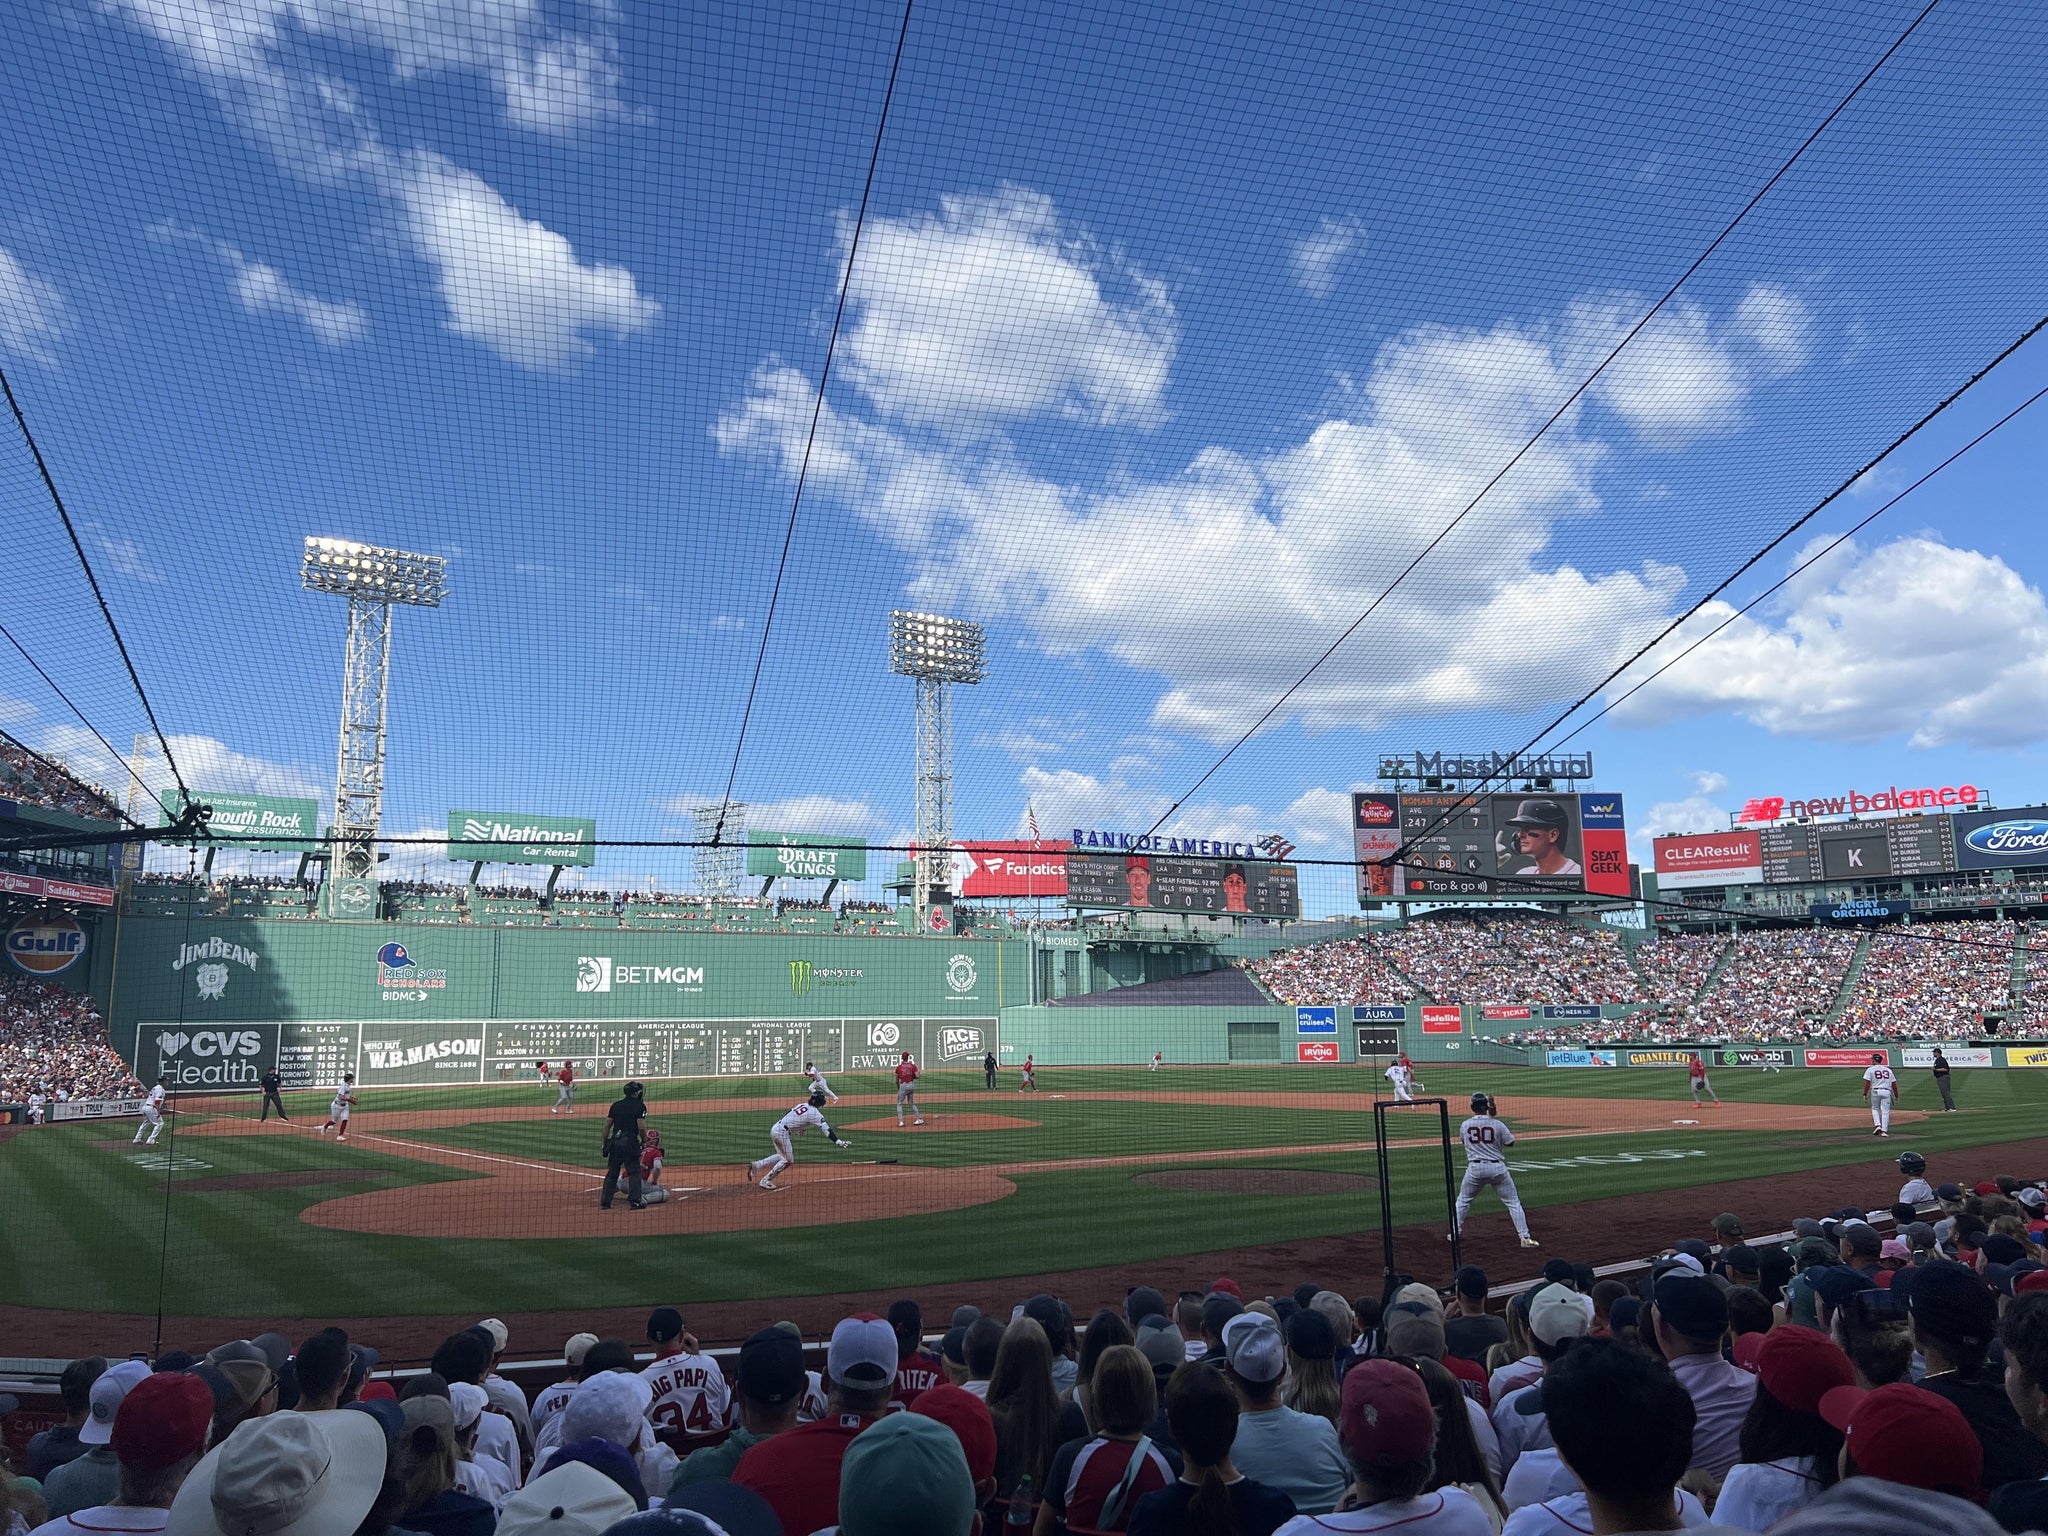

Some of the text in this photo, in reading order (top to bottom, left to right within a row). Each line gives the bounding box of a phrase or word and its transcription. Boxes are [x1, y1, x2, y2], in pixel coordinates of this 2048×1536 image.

[1415, 751, 1593, 777] MassMutual
[1402, 797, 1433, 806] ROMAN
[1790, 784, 1978, 817] new balance
[260, 811, 302, 828] Rock
[1473, 818, 1478, 827] 7
[1820, 821, 1885, 832] SCORE THAT PLAY
[1987, 826, 2048, 849] Ford
[1073, 829, 1256, 858] BANK OF AMERICA
[522, 847, 578, 857] Car Rental
[777, 848, 838, 863] DRAFT
[1591, 851, 1620, 861] SEAT
[1665, 842, 1750, 860] CLEAResult
[1847, 848, 1863, 867] K
[785, 861, 837, 875] KINGS
[1006, 862, 1066, 876] Fanatics
[1439, 860, 1452, 868] BB
[1591, 863, 1622, 874] GEEK
[1178, 886, 1199, 894] STRIKES
[1427, 881, 1475, 892] Tap & go
[1164, 894, 1213, 908] 0 0 2
[1839, 900, 1879, 909] ANGRY
[1832, 908, 1889, 918] ORCHARD
[8, 931, 81, 952] Gulf
[1040, 937, 1079, 946] ABIOMED
[385, 968, 446, 979] RED SOX
[615, 966, 703, 984] BETMGM
[384, 979, 446, 988] SCHOLARS
[383, 991, 416, 1001] BIDMC
[1299, 1013, 1312, 1021] city
[1423, 1014, 1460, 1022] Safelite
[1502, 1008, 1529, 1017] TICKET
[946, 1028, 980, 1044] ACE
[191, 1031, 261, 1056] CVS
[363, 1041, 400, 1050] WHO BUT
[947, 1041, 980, 1054] TICKET
[1304, 1048, 1332, 1056] IRVING
[1550, 1051, 1586, 1064] jetBlue
[1630, 1052, 1674, 1064] GRANITE
[280, 1062, 306, 1070] BOSTON
[327, 1061, 336, 1069] 65
[161, 1059, 260, 1084] Health
[326, 1078, 335, 1086] 75
[85, 1104, 103, 1113] TRULY
[1467, 1126, 1495, 1144] 30
[673, 1368, 708, 1389] PAPI
[653, 1392, 713, 1434] 34
